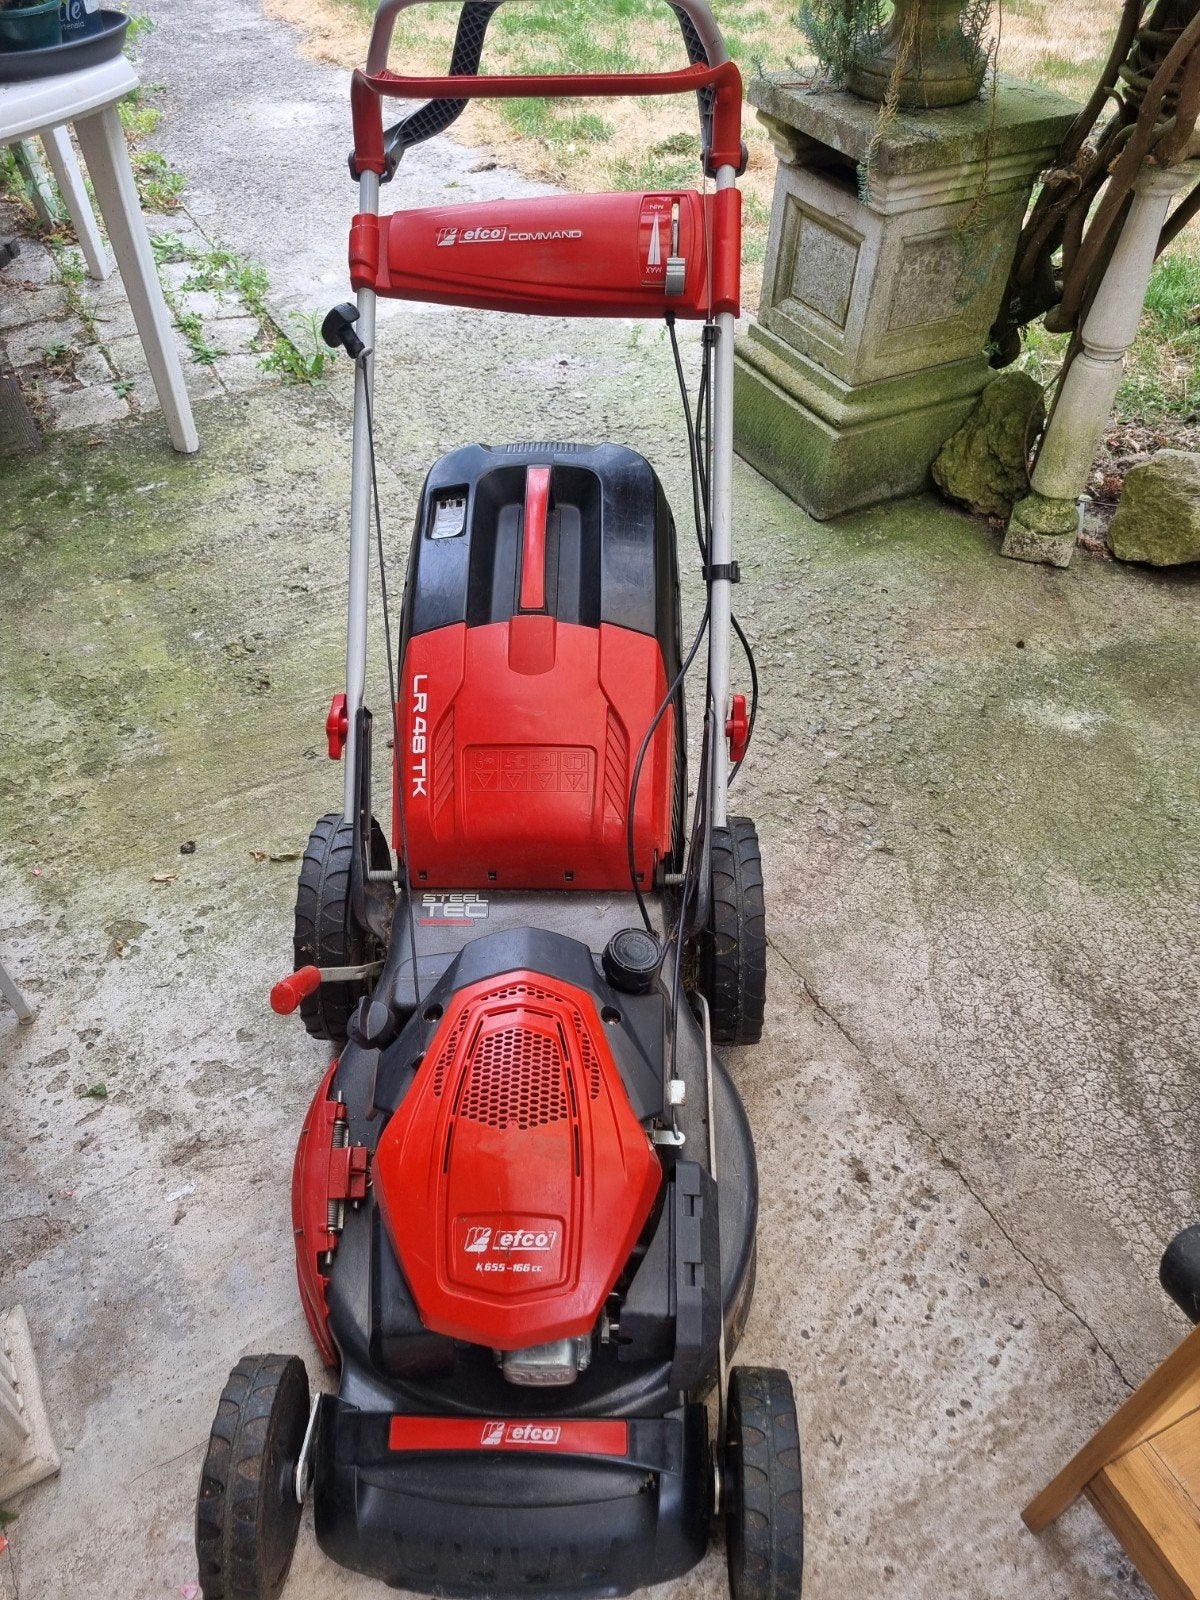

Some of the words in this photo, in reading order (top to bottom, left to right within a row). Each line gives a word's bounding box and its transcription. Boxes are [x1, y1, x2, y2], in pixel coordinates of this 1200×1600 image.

[463, 226, 501, 240] efco
[508, 230, 582, 241] COMMAND
[422, 893, 489, 903] STEEL
[421, 902, 488, 918] TEC
[500, 1229, 548, 1247] efco
[512, 1424, 554, 1441] efco
